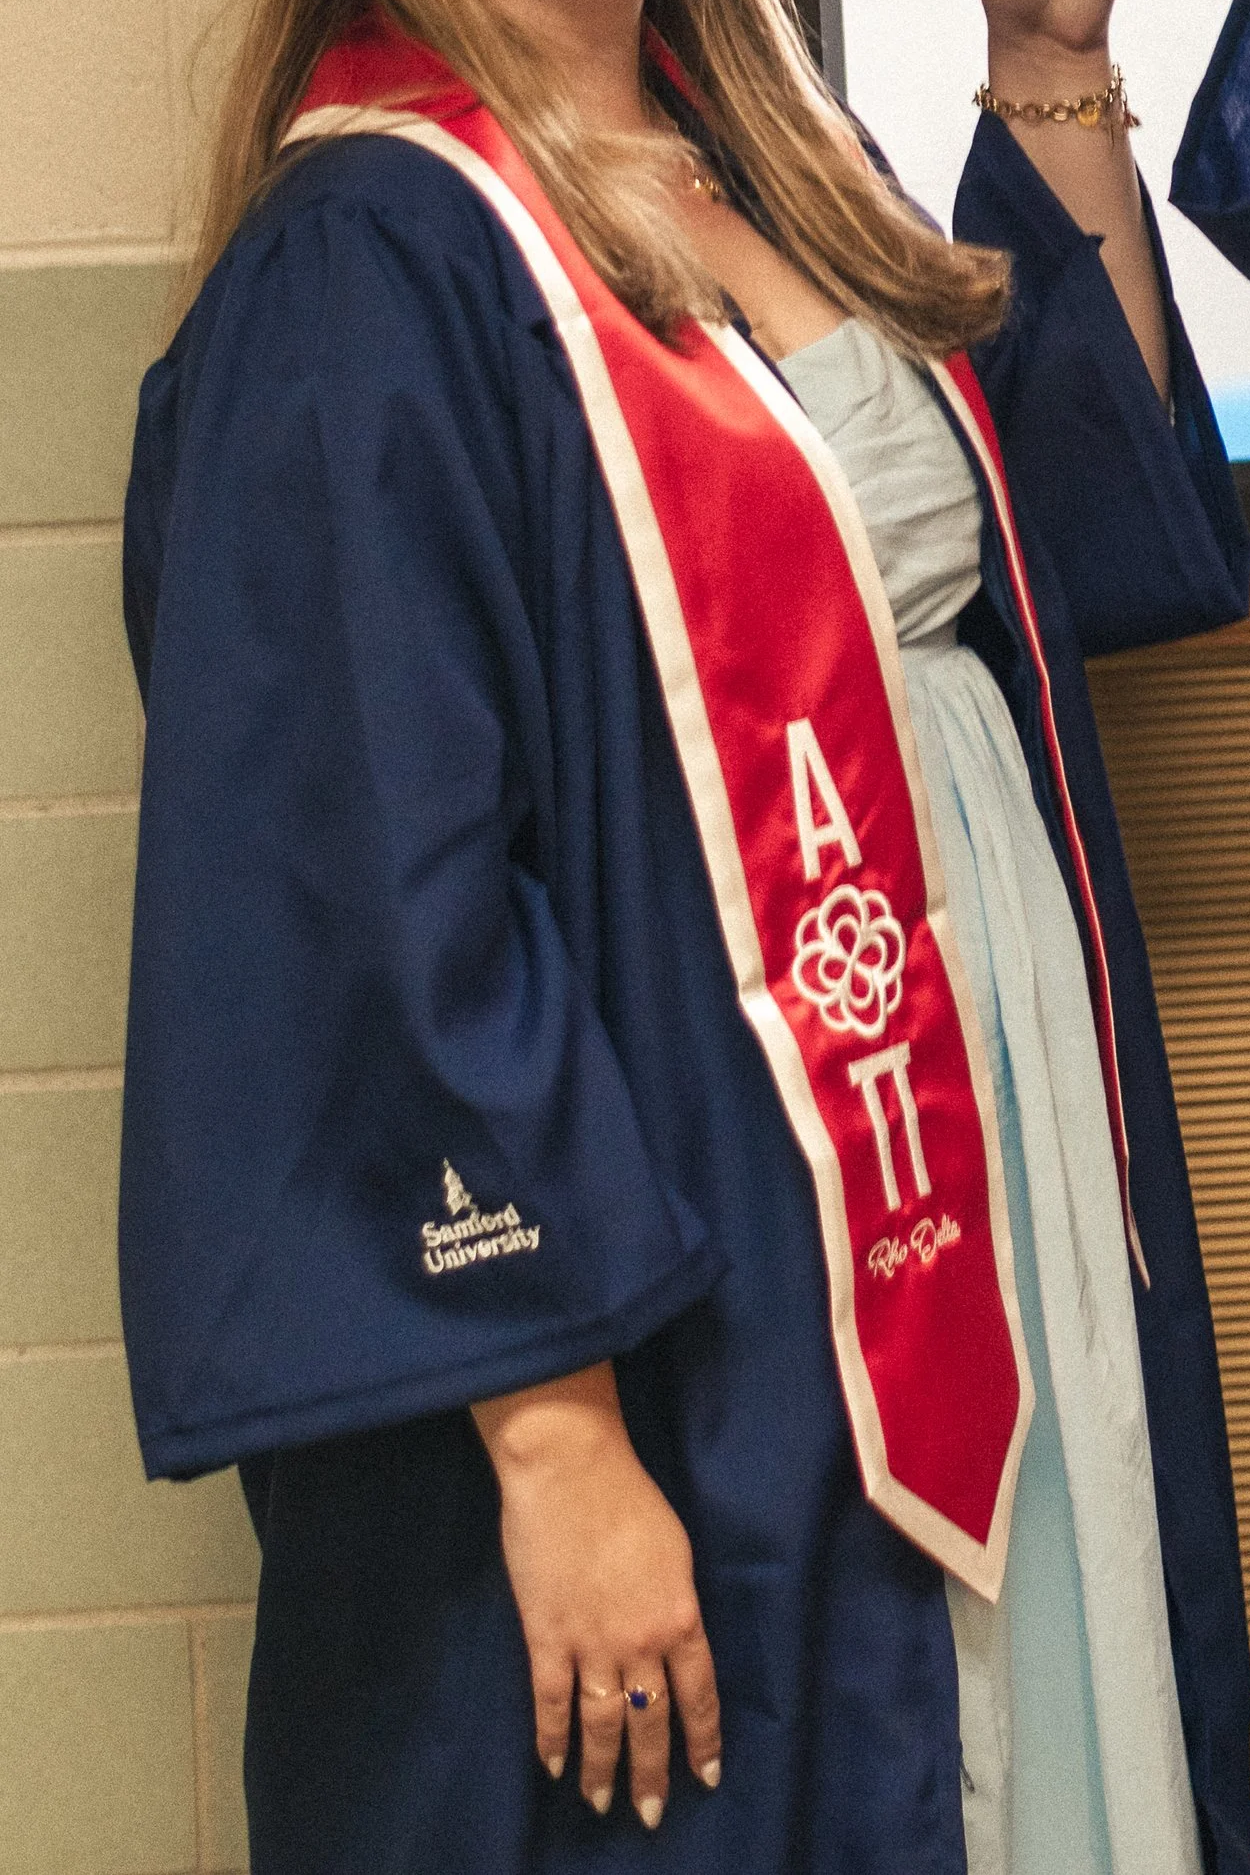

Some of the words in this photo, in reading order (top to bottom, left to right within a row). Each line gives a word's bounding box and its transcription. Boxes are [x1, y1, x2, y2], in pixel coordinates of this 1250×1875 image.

[422, 1203, 521, 1247] Samford
[423, 1225, 541, 1273] University
[868, 1236, 908, 1278] Rho
[911, 1213, 961, 1263] Delta
